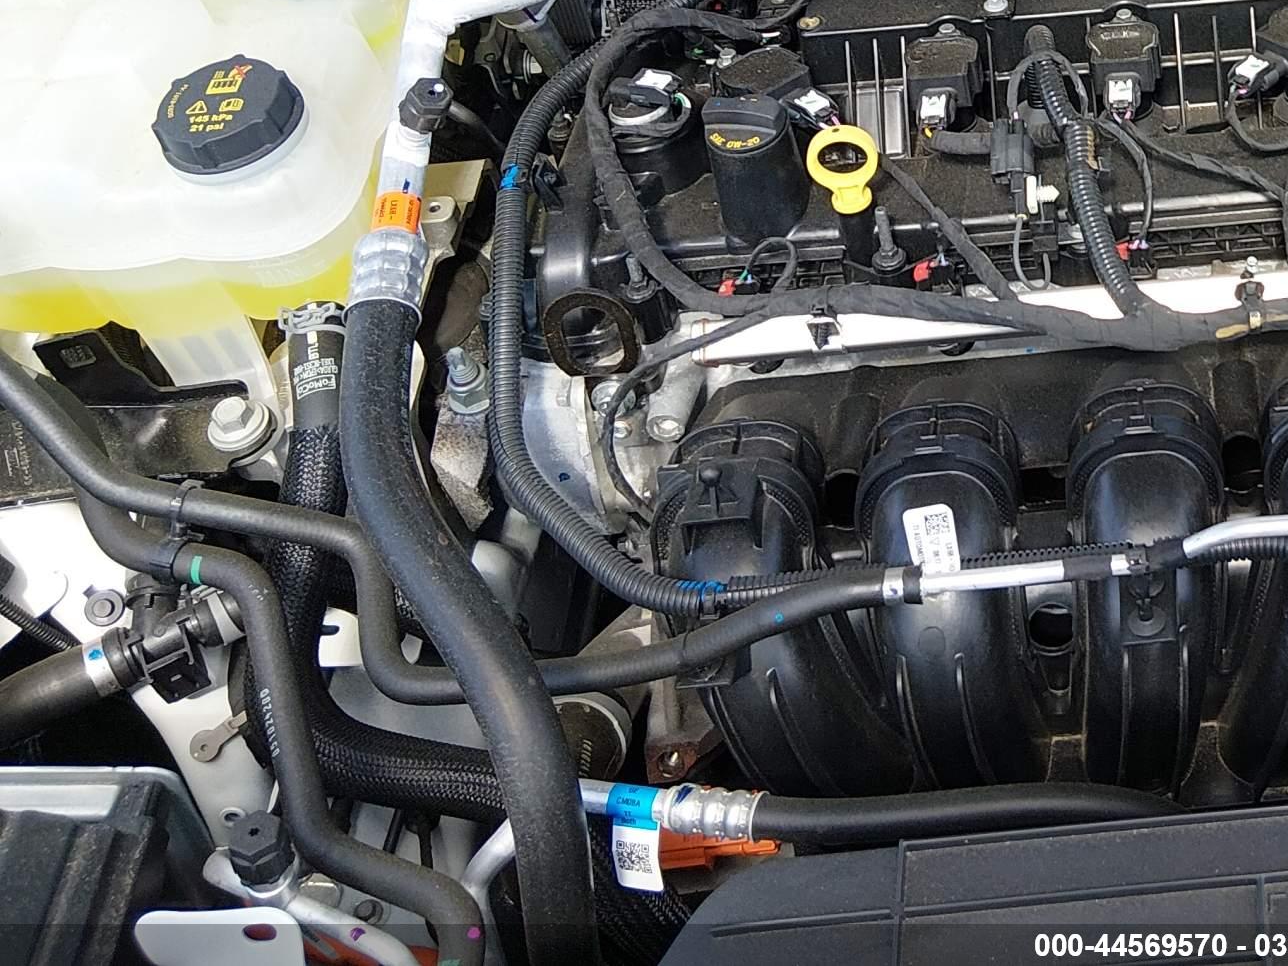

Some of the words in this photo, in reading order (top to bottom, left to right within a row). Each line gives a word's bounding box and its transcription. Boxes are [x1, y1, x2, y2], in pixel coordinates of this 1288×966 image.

[189, 114, 210, 123] 145
[189, 124, 203, 132] 21
[205, 123, 224, 132] psi
[710, 132, 726, 146] SAE
[726, 136, 760, 149] 0W-20
[298, 377, 336, 394] FoMoCo
